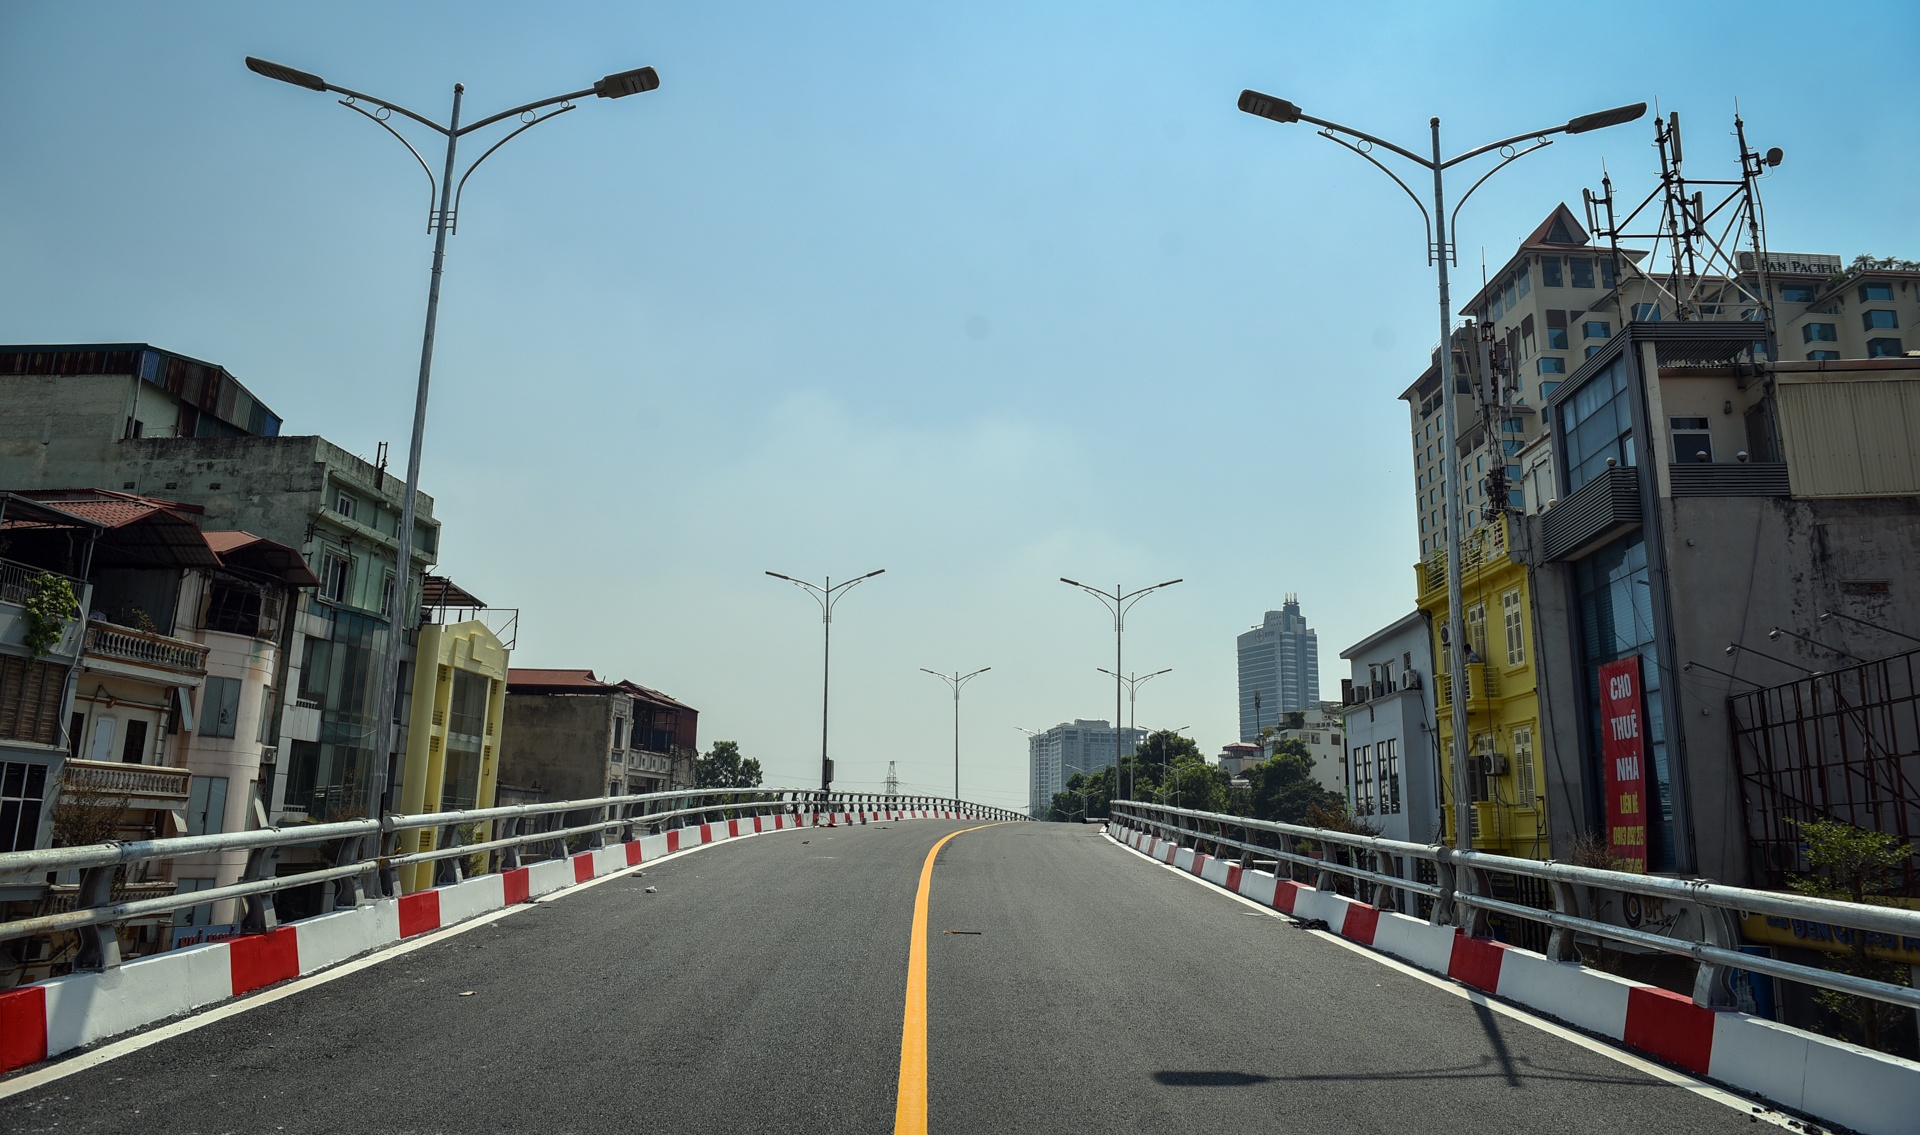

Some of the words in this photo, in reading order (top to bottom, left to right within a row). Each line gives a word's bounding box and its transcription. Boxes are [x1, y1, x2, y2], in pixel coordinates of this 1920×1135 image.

[1792, 261, 1841, 274] PACIFIC
[1610, 673, 1632, 701] CHO
[1610, 708, 1639, 741] THUÊ
[1616, 750, 1640, 782] NHÀ
